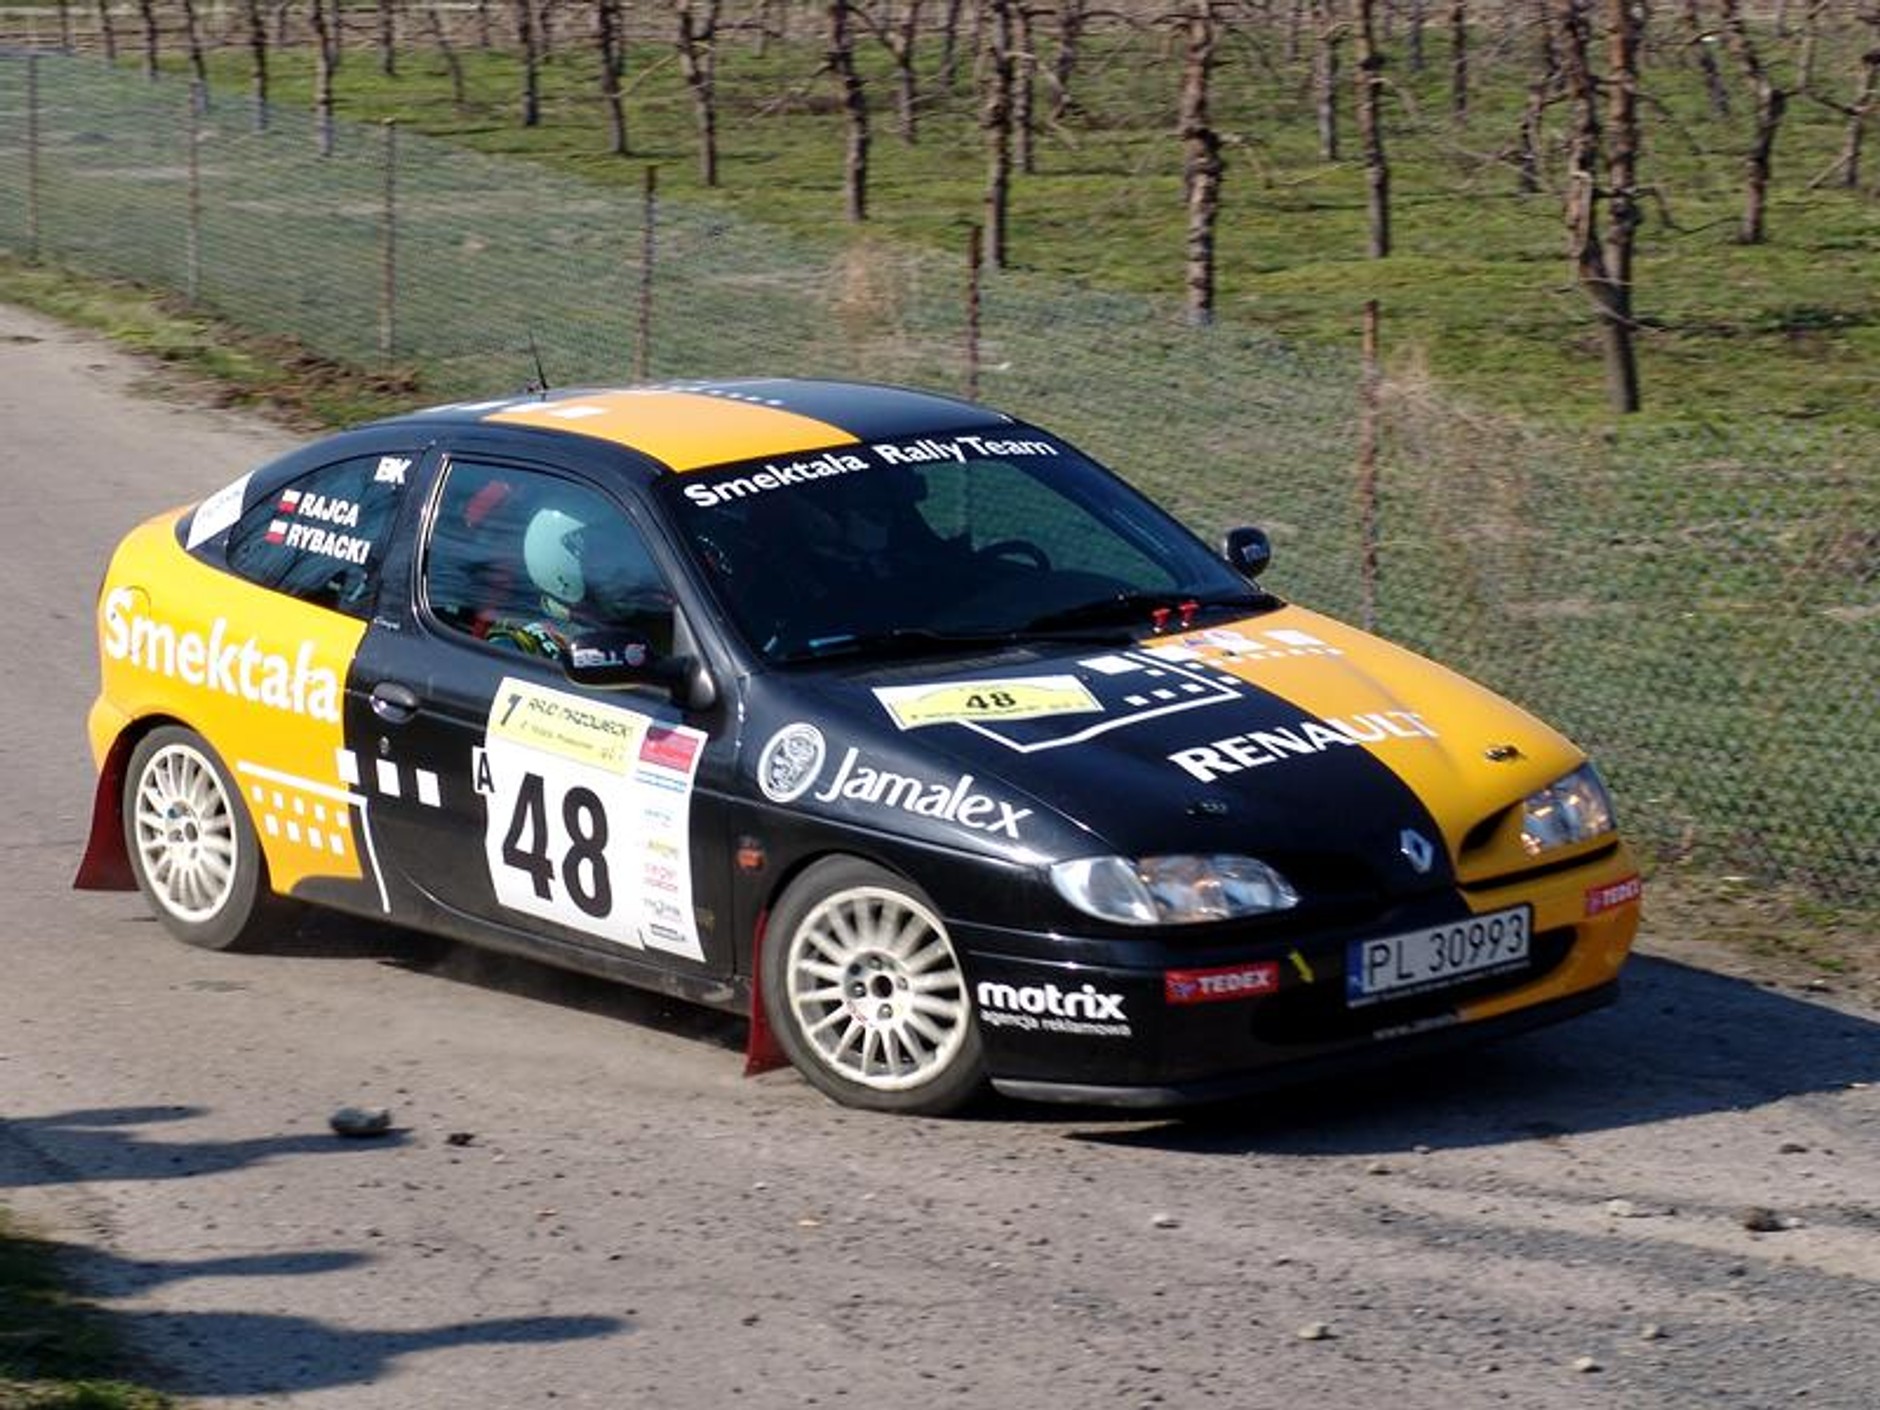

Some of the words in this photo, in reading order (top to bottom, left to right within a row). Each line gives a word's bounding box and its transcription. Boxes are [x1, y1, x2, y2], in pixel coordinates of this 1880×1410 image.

[374, 457, 412, 484] BK
[872, 439, 966, 464] Rally
[955, 436, 1058, 457] Team
[298, 492, 359, 527] RAJCA
[285, 523, 371, 565] RYBACKI
[103, 586, 341, 724] Smektała
[965, 691, 1017, 709] 48
[1167, 710, 1439, 783] RENAULT
[477, 751, 495, 793] A
[815, 747, 1033, 839] Jamalex
[502, 771, 613, 920] 48
[1368, 941, 1414, 985] PL
[1428, 914, 1524, 973] 30993
[977, 980, 1128, 1020] matrix
[1199, 969, 1270, 994] TEDEX
